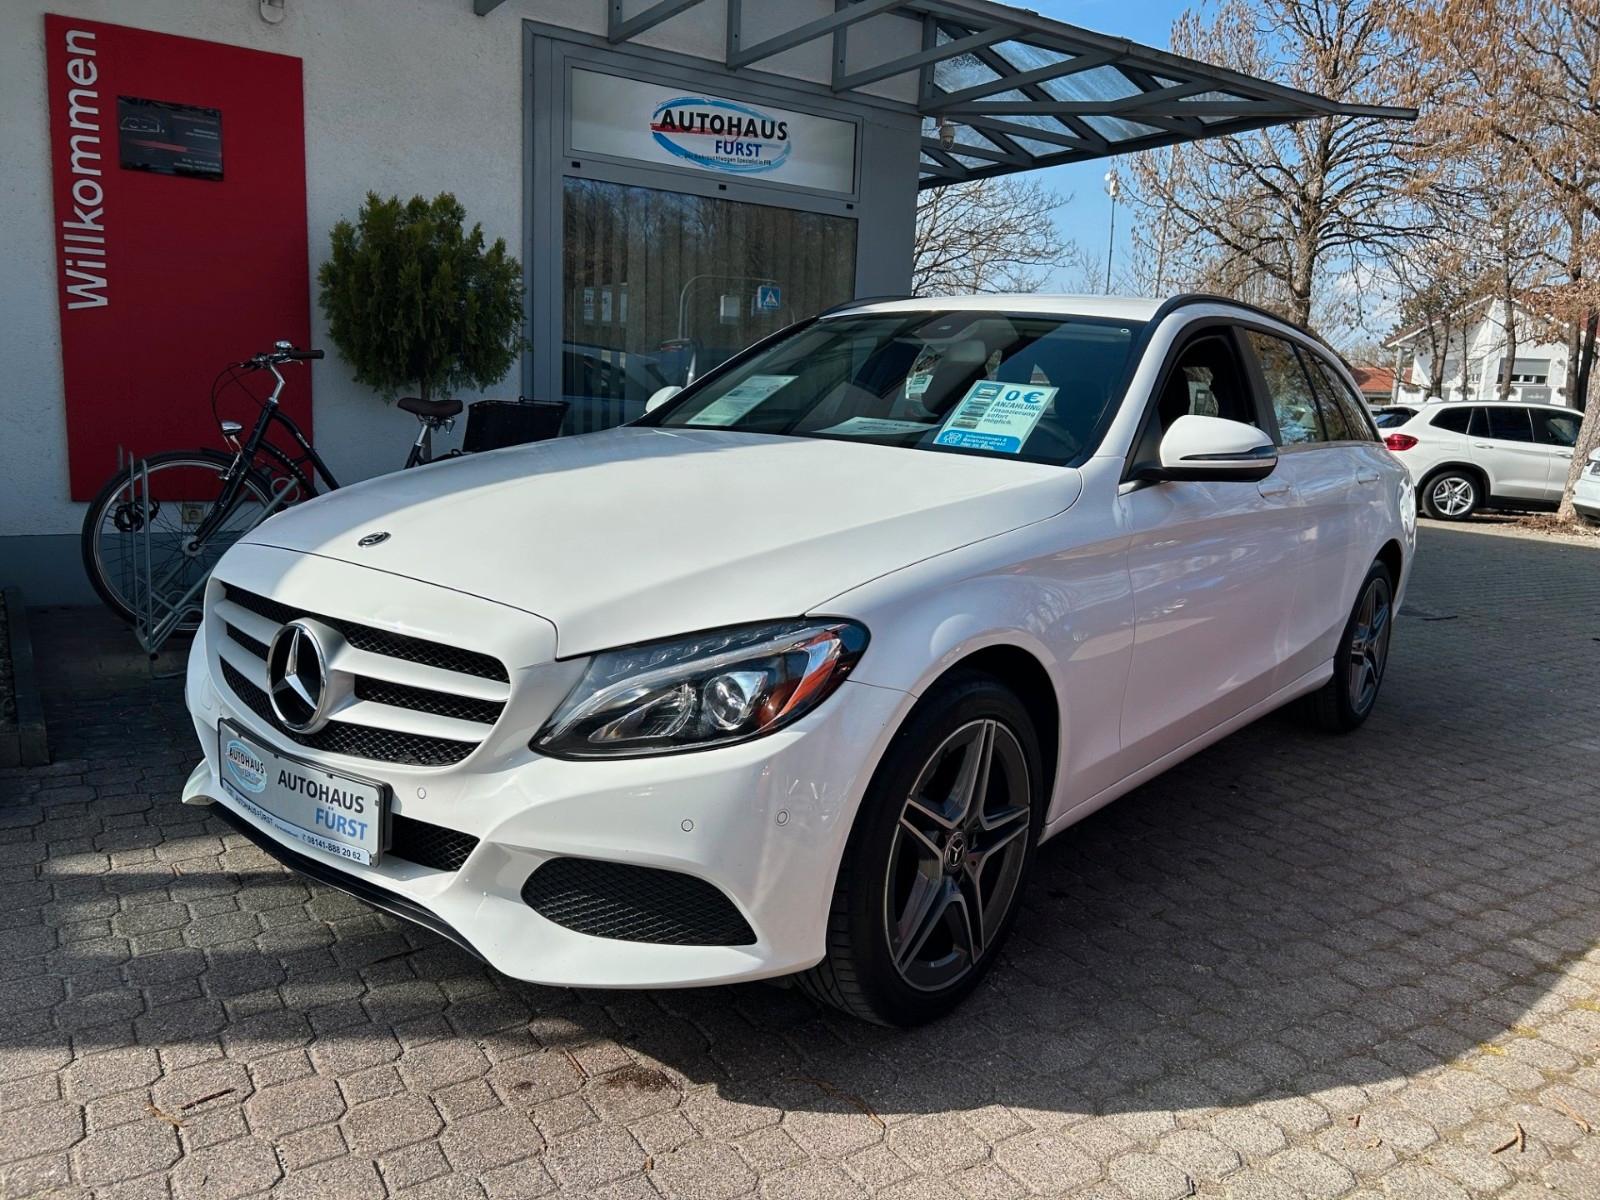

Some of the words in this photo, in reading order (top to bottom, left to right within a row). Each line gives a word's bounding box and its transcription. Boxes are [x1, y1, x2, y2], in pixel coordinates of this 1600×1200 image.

[660, 109, 787, 140] AUTOHAUS
[63, 29, 108, 309] Willkommen
[994, 401, 1041, 411] ANZAHLUNG
[1005, 390, 1020, 401] 0
[1023, 391, 1044, 404] €
[230, 748, 264, 774] AUTOHAUS
[278, 770, 364, 813] AUTOHAUS
[315, 807, 367, 840] FÜRST
[342, 848, 351, 857] 20
[352, 852, 361, 861] 62
